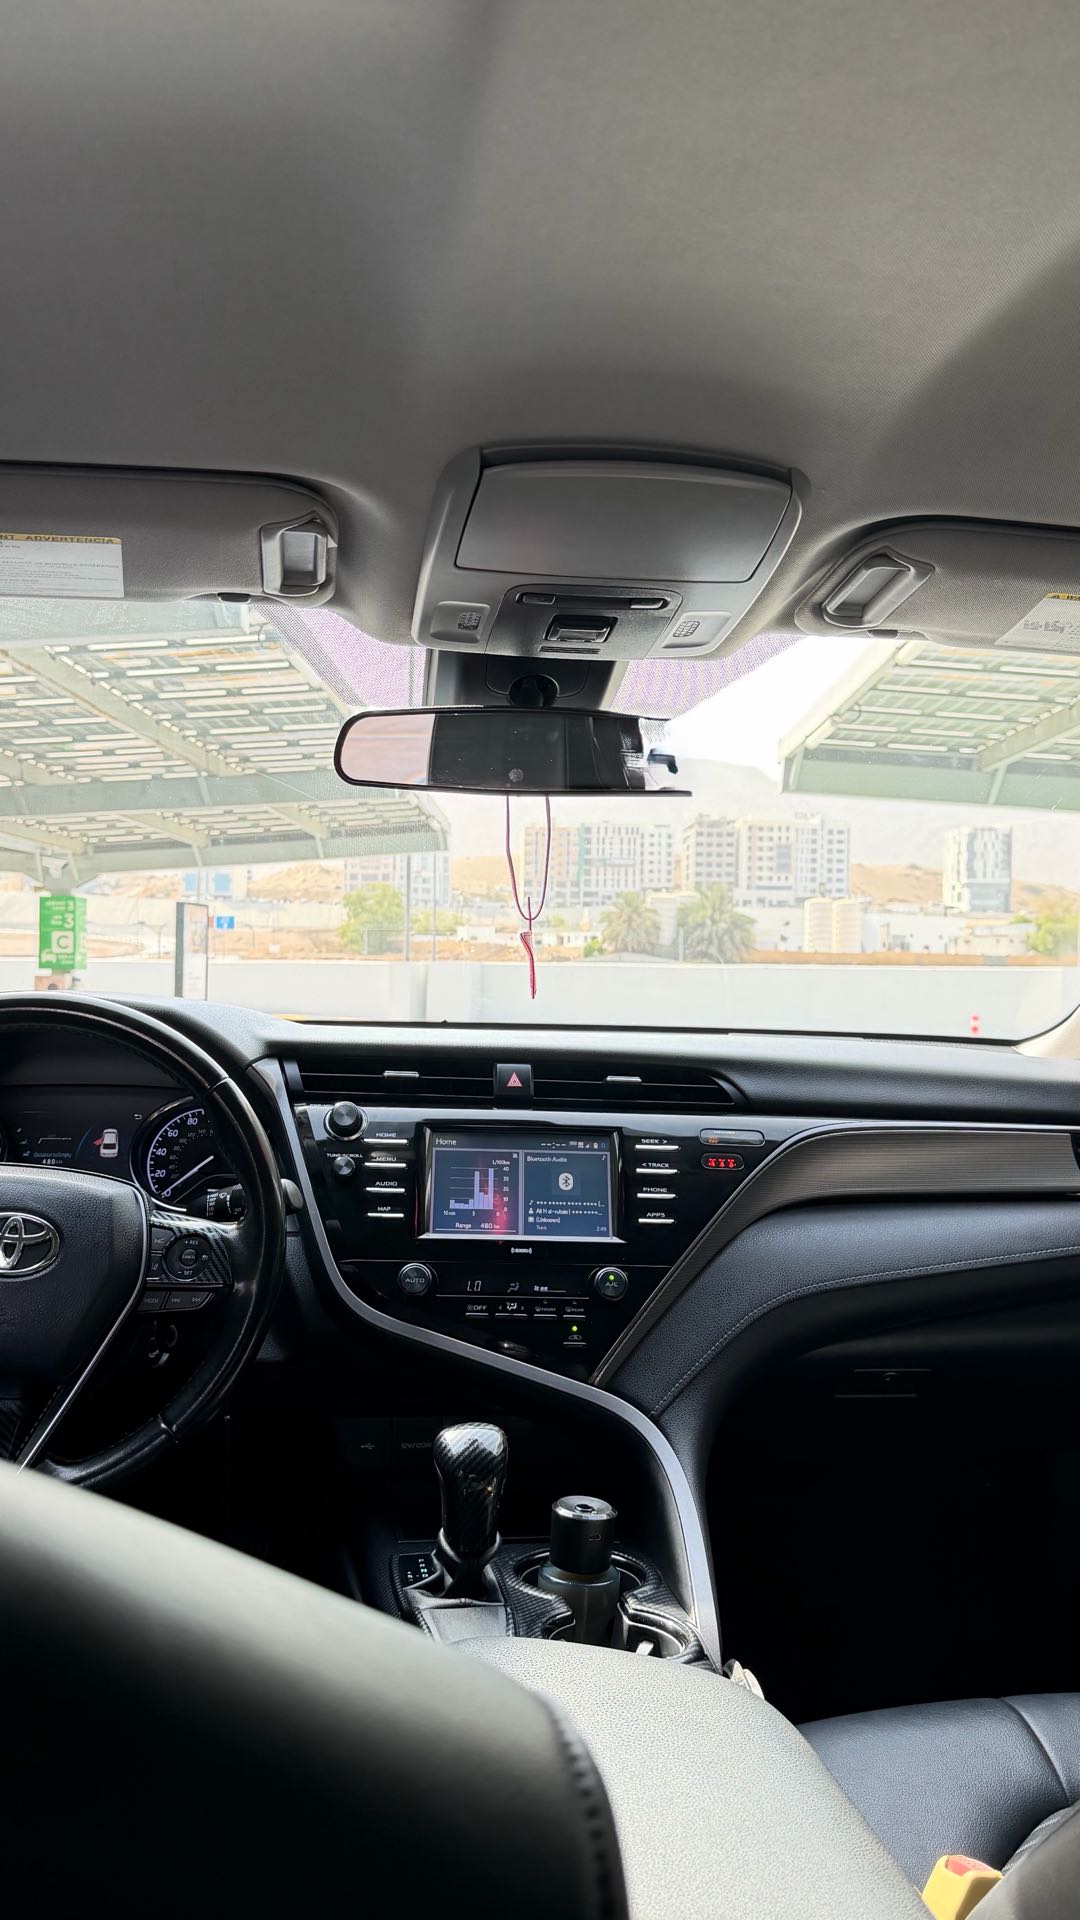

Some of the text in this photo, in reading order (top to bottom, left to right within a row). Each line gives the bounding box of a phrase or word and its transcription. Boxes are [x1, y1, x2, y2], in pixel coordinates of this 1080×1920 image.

[25, 535, 114, 544] ADVERTENCIA
[64, 912, 74, 928] 3
[57, 935, 70, 949] C
[167, 1129, 179, 1137] 60
[435, 1138, 457, 1146] Home
[155, 1147, 167, 1156] 40
[154, 1169, 166, 1178] 20
[466, 1280, 482, 1292] LO
